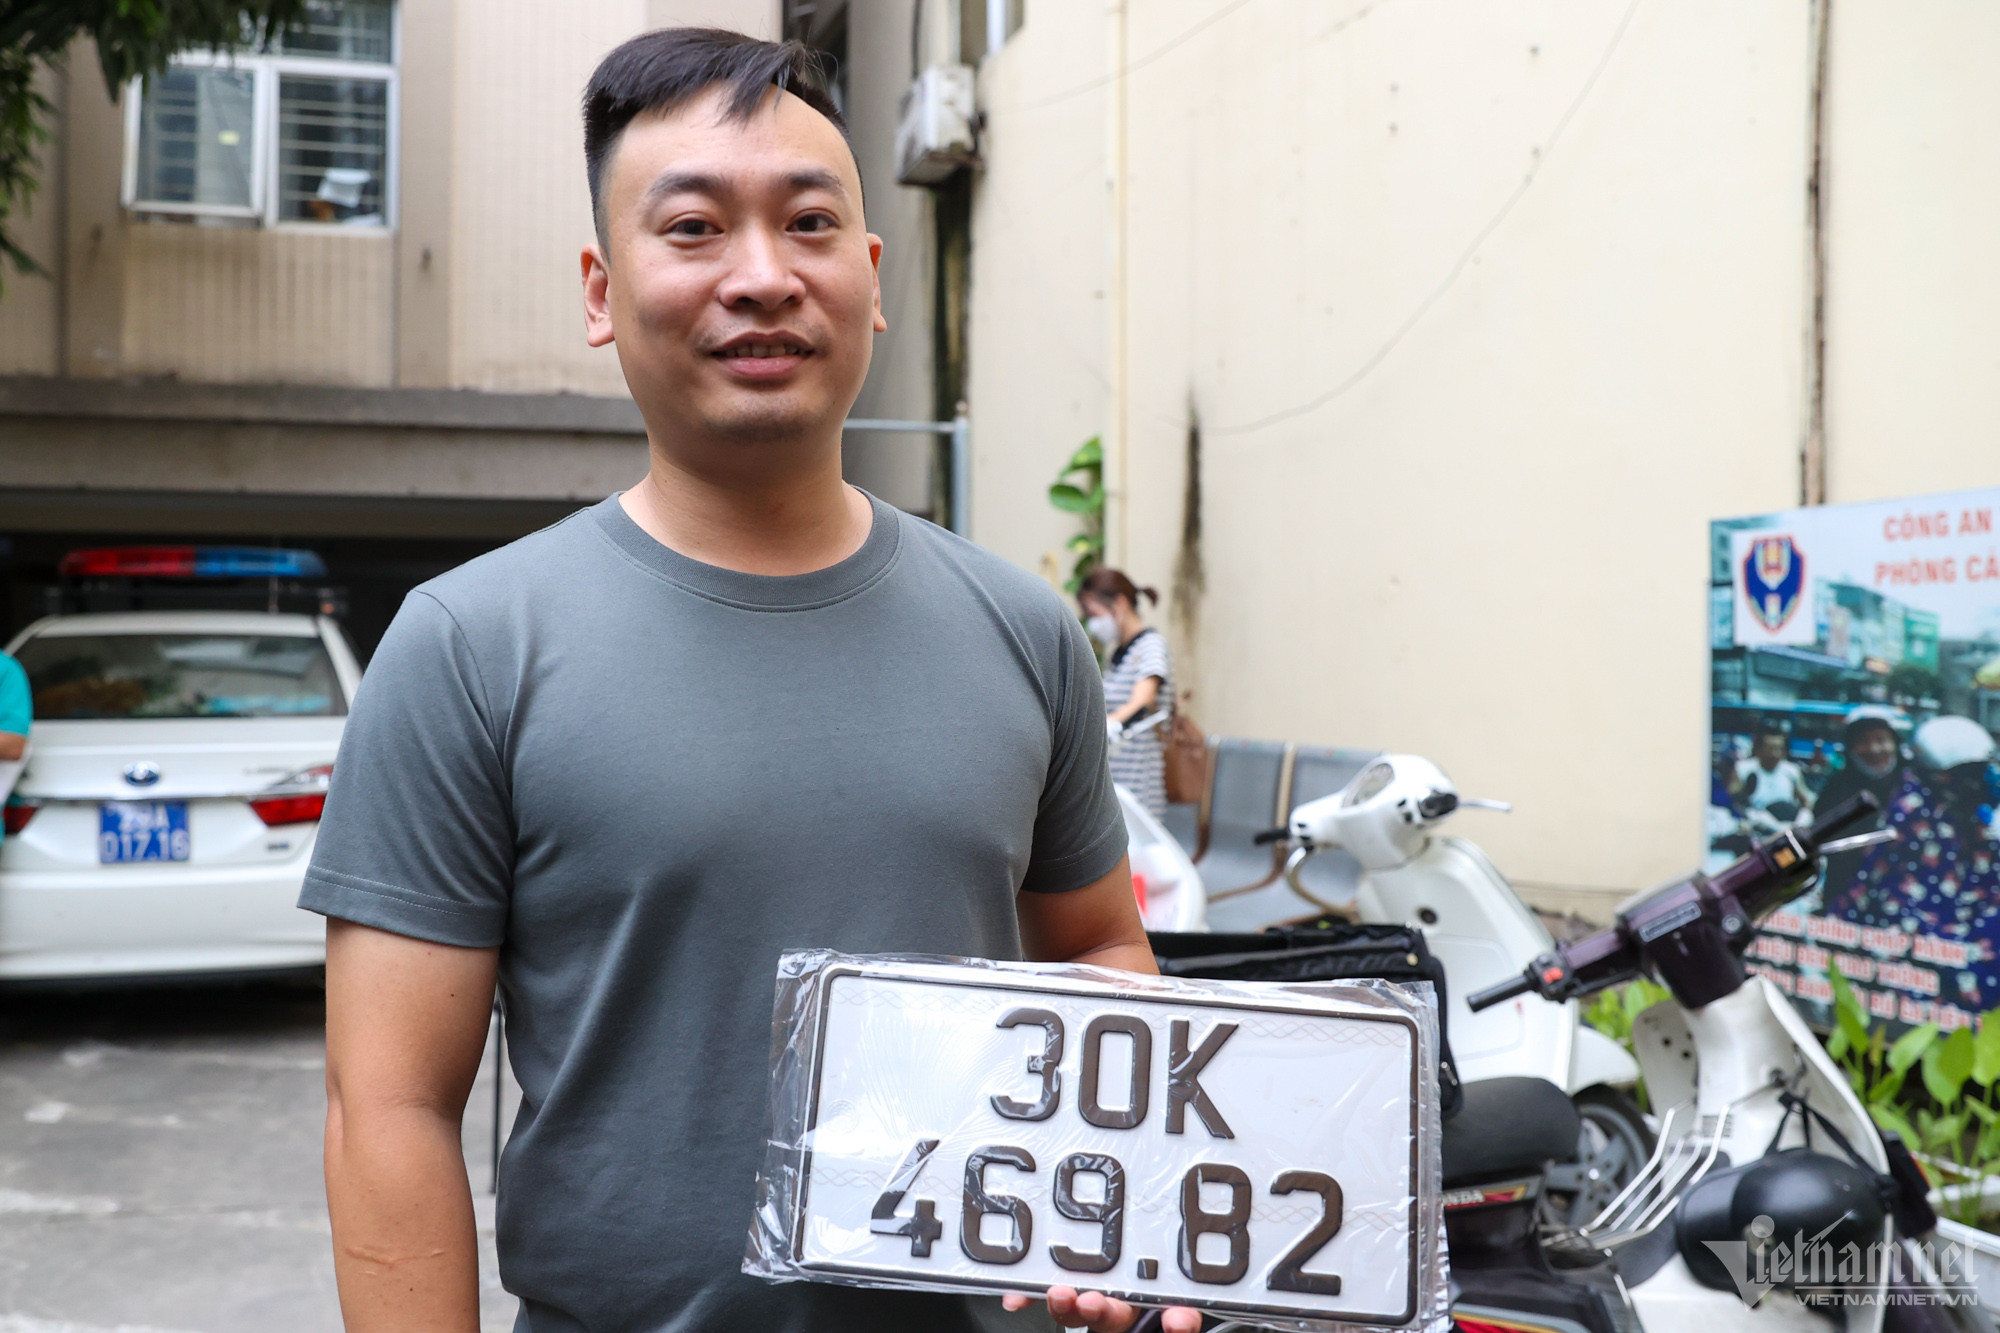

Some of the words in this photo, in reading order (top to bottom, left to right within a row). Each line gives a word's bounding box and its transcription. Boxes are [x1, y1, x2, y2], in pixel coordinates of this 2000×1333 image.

[1958, 508, 1993, 536] AN
[990, 1006, 1240, 1139] 30K
[869, 1137, 1344, 1297] 469.82
